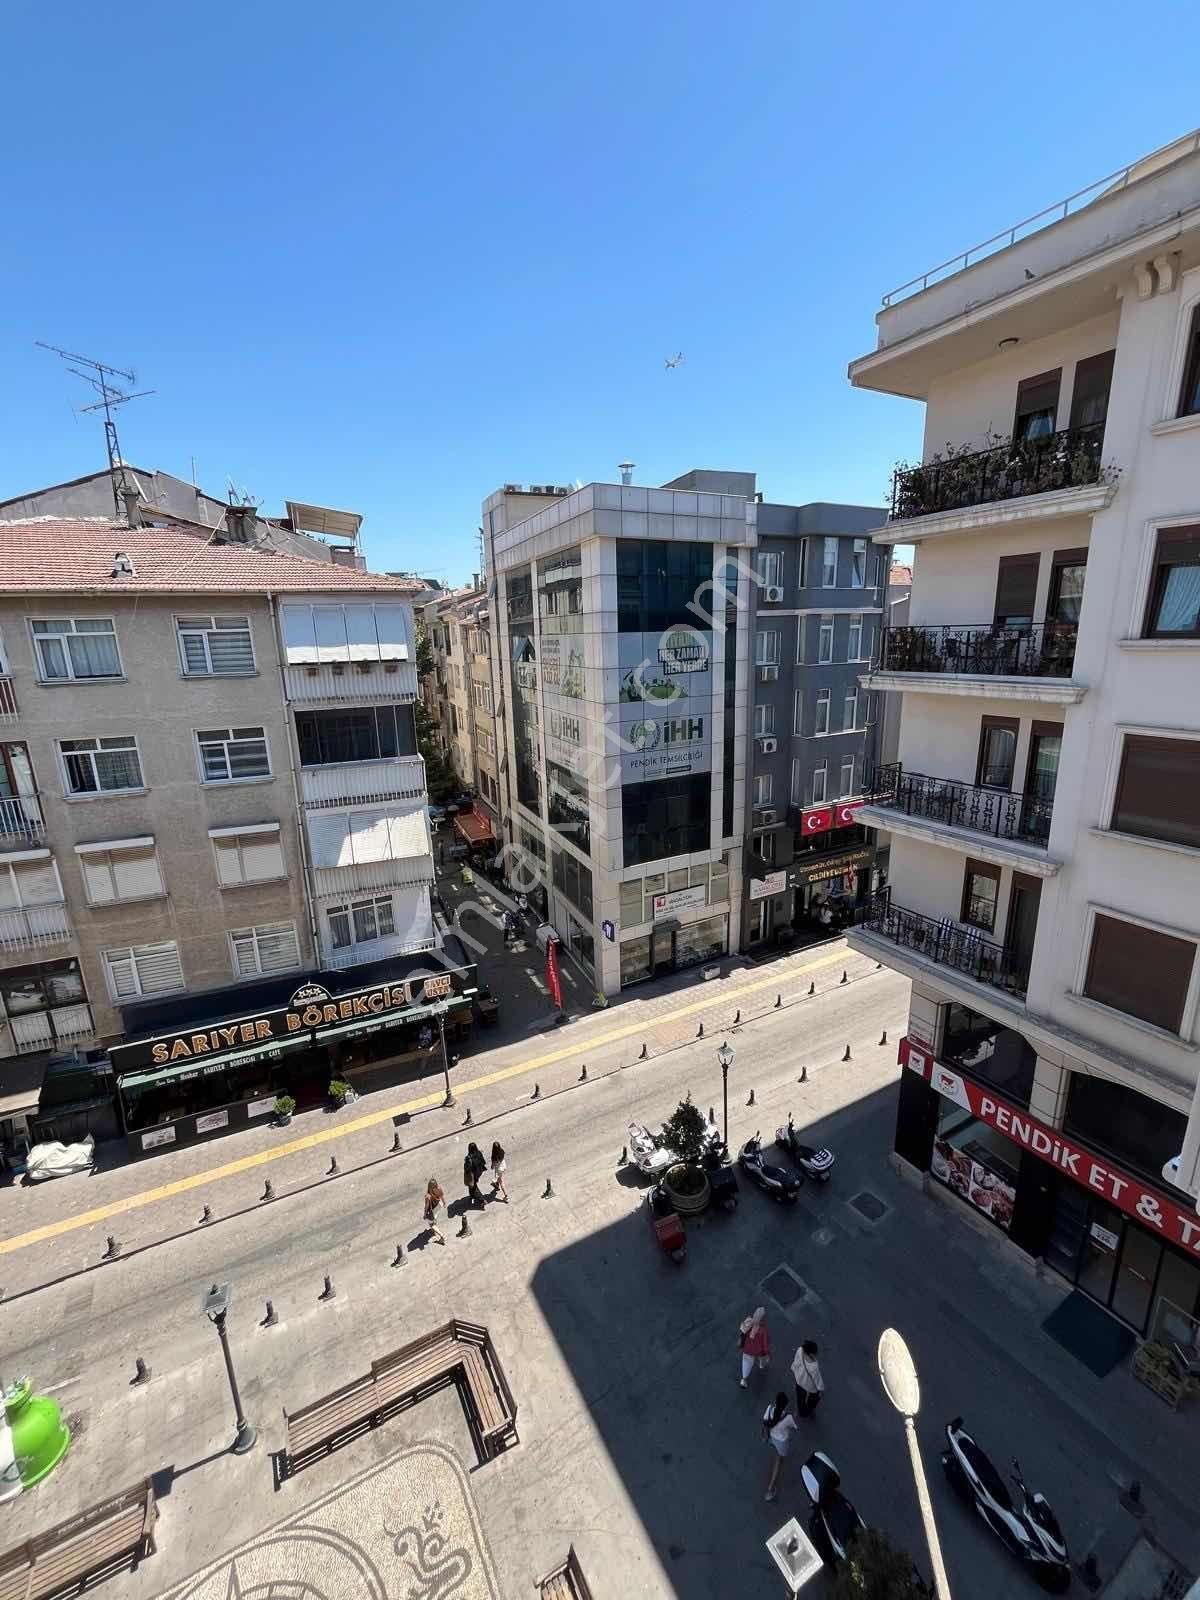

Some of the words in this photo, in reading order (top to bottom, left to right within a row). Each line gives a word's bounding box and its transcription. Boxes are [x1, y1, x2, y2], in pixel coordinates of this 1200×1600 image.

[151, 1019, 272, 1064] SARIYER
[1088, 1165, 1129, 1200] ET
[1135, 1194, 1163, 1228] &
[1177, 1215, 1200, 1250] T
